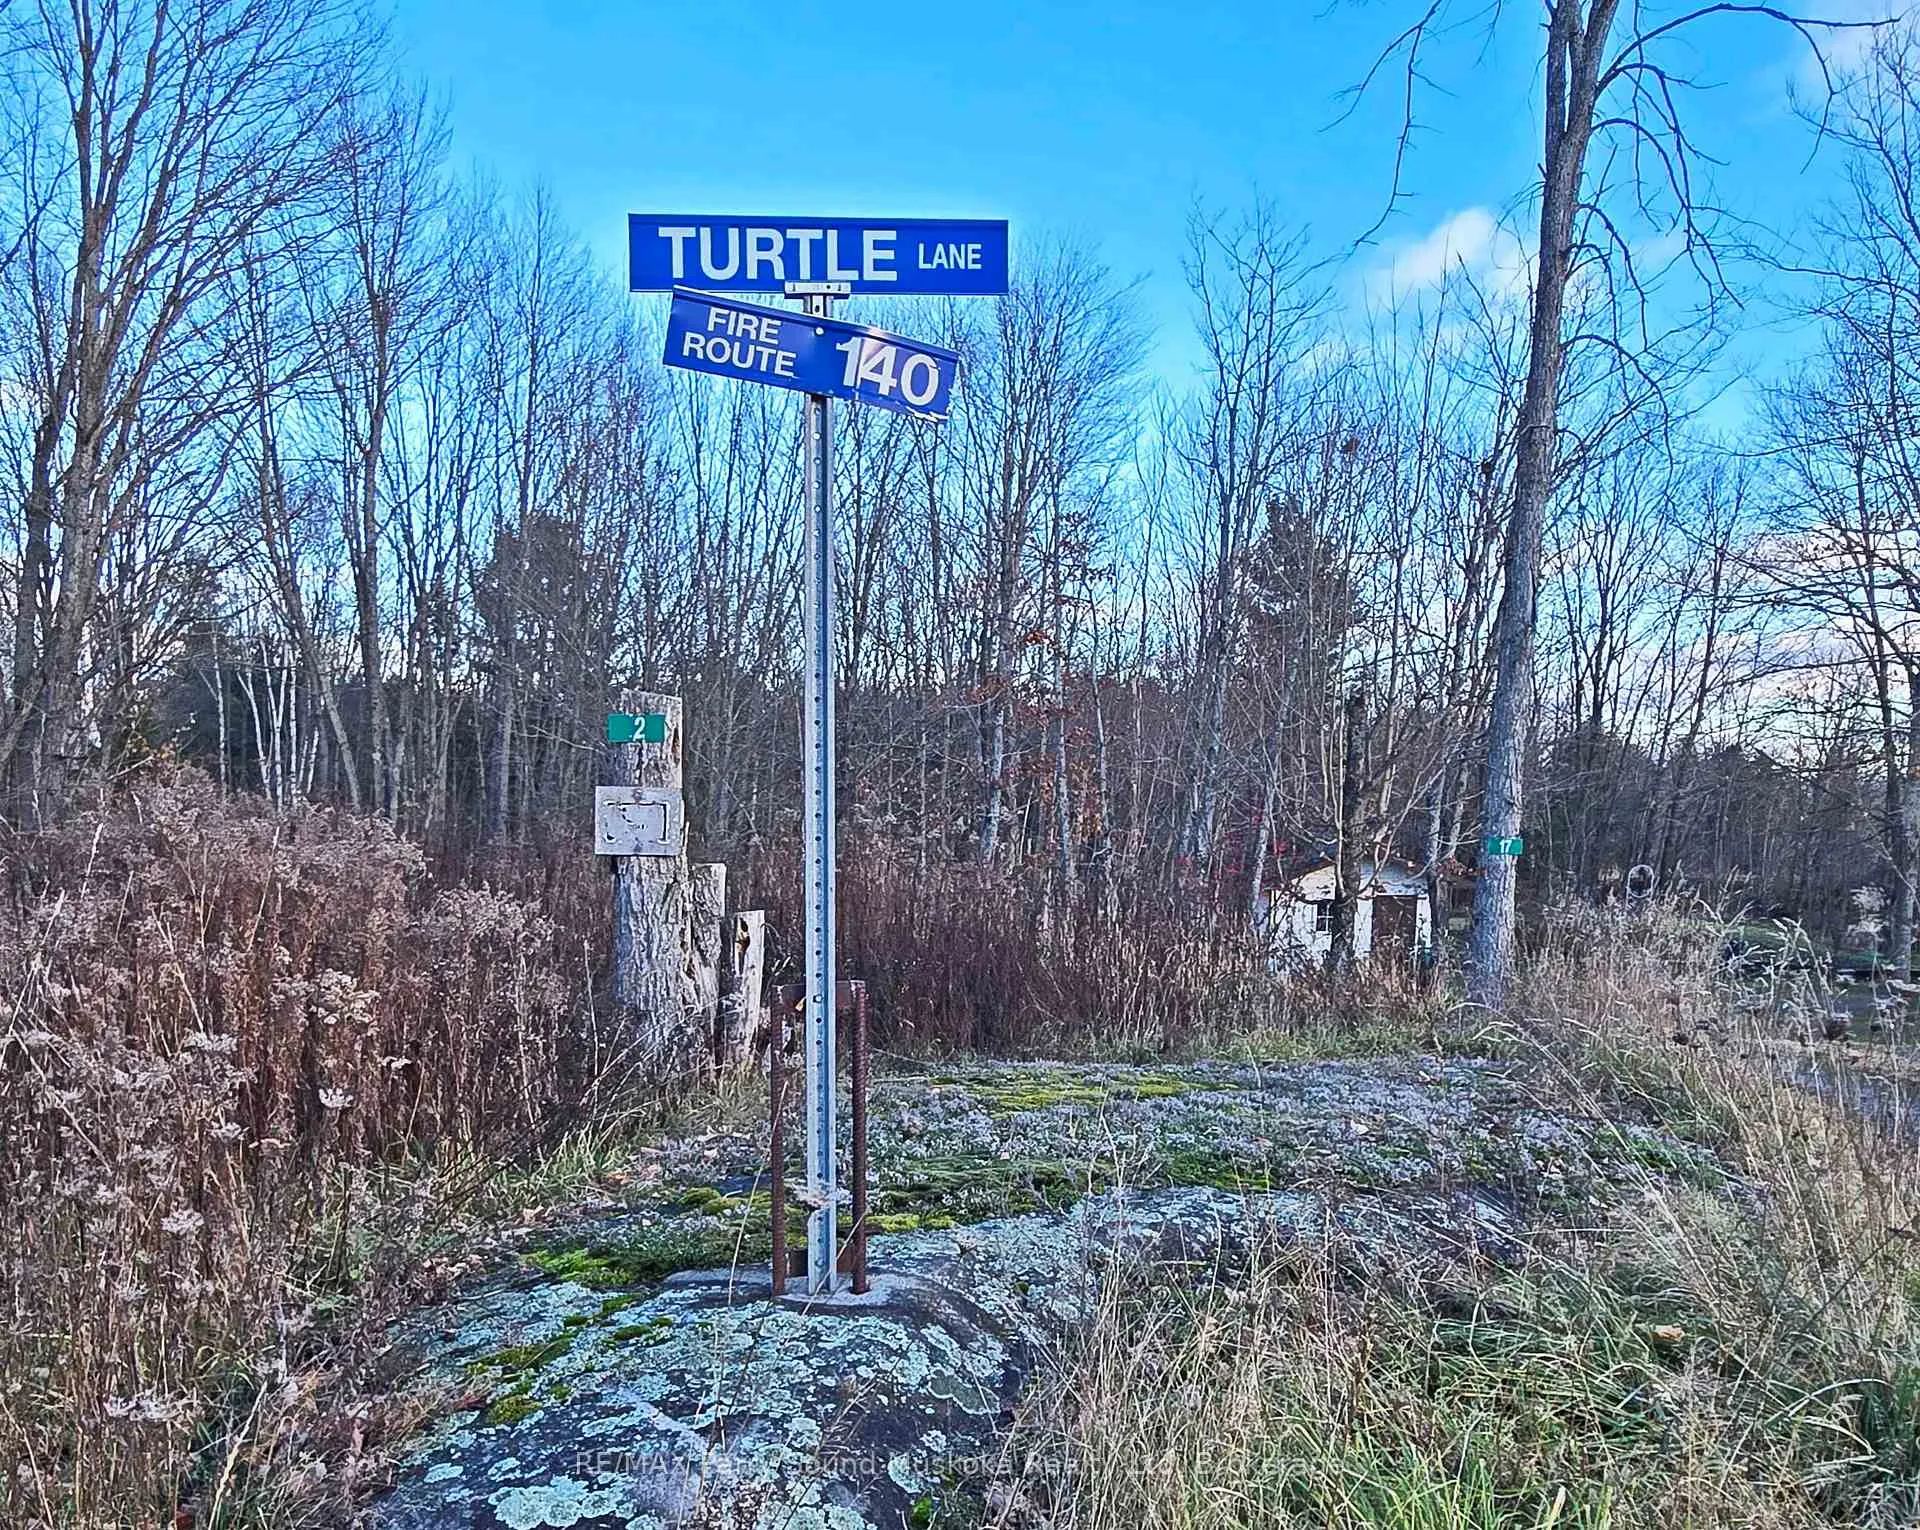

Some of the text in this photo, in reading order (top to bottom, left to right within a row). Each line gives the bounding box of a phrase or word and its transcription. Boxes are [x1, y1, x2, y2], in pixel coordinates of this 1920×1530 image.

[658, 226, 982, 281] TURTLE LANE
[707, 308, 782, 345] FIRE
[683, 332, 940, 406] ROUTE 140
[633, 717, 646, 742] 2
[1499, 839, 1512, 853] 17
